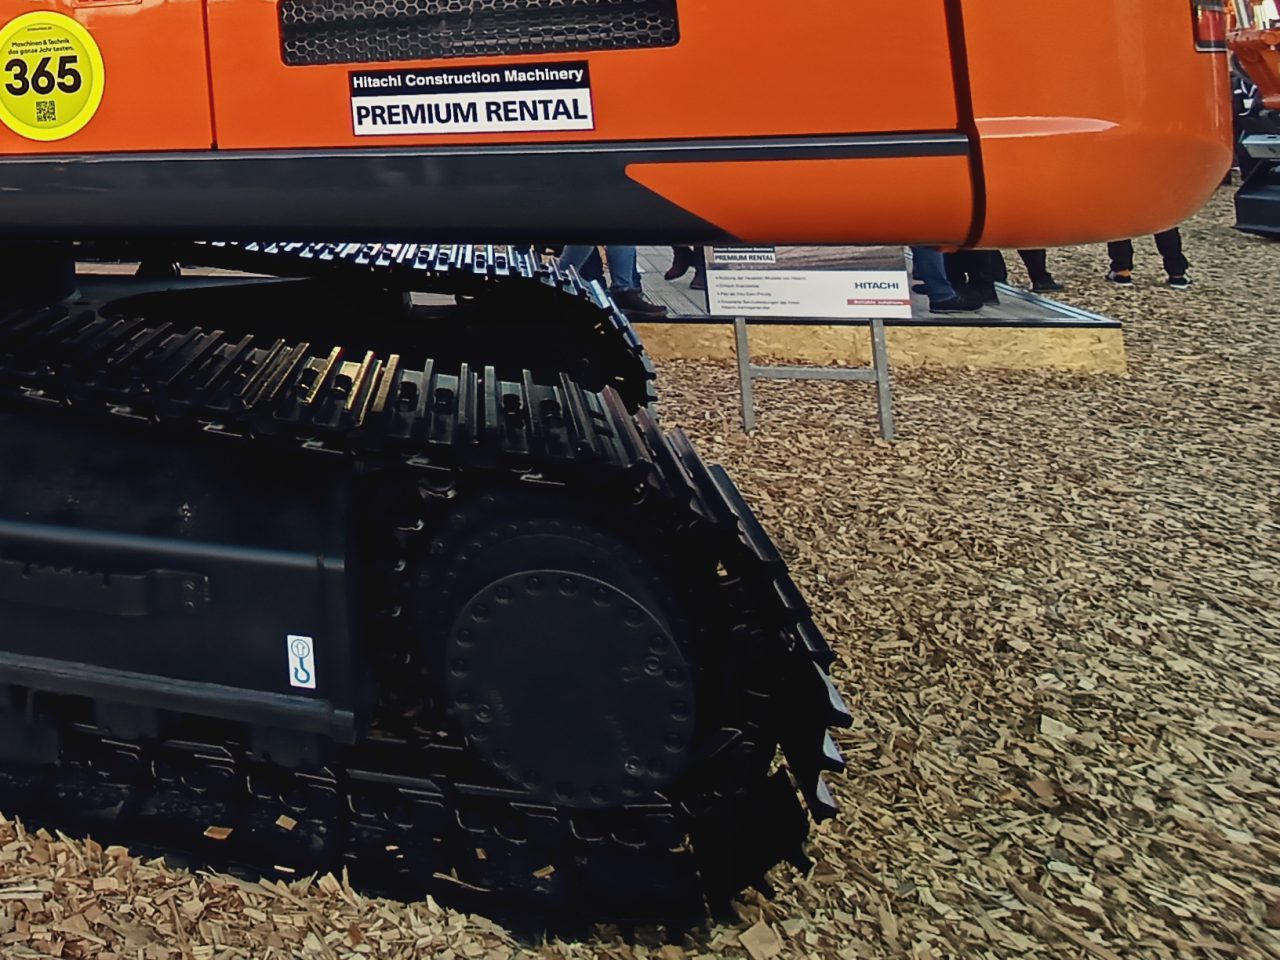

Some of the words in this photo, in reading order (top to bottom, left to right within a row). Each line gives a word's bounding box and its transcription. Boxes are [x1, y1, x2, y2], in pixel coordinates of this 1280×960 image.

[5, 55, 81, 96] 365
[353, 76, 402, 89] Hitachi
[405, 71, 501, 87] Construction
[505, 68, 584, 83] Machinery
[356, 102, 478, 126] PREMIUM
[485, 98, 588, 122] RENTAL
